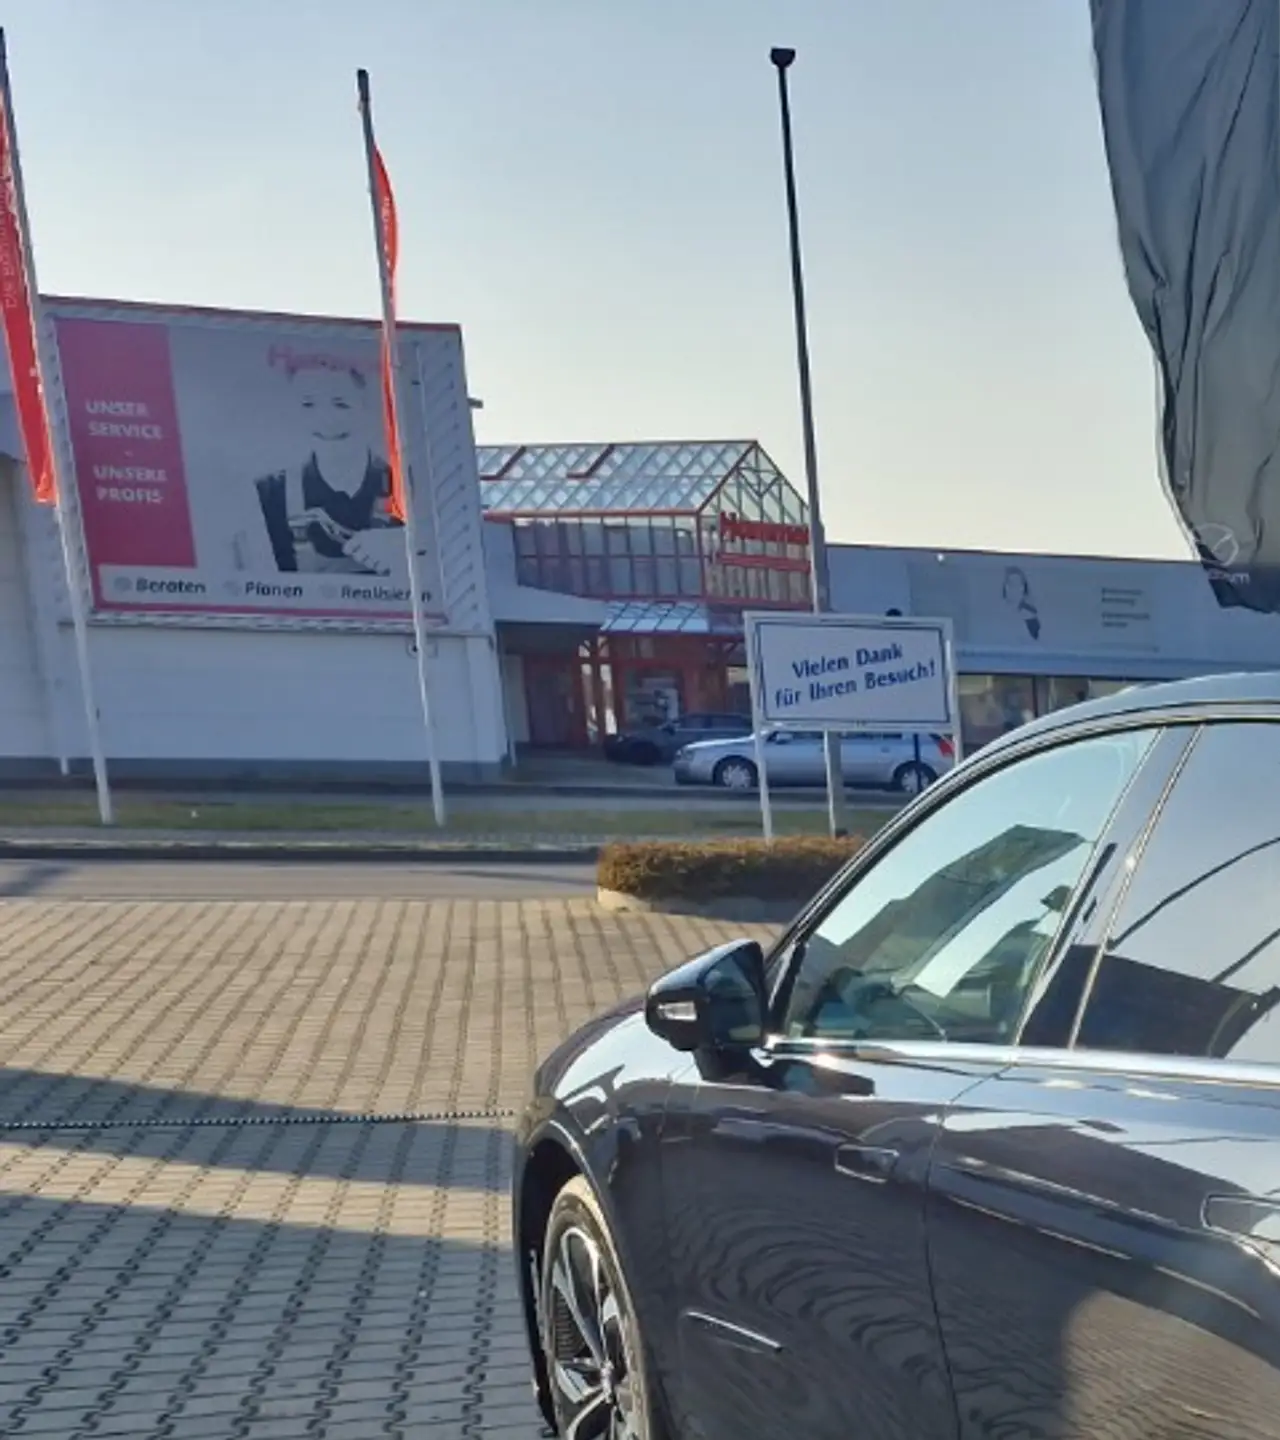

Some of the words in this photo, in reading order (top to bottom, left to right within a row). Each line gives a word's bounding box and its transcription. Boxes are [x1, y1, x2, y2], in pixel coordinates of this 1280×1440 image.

[85, 400, 150, 417] UNSER
[88, 421, 164, 439] SERVICE
[93, 464, 168, 482] UNSERE
[135, 577, 206, 594] Beraten
[245, 581, 303, 598] Planen
[341, 585, 432, 603] Realisiern
[792, 655, 849, 678] Vielen
[856, 643, 903, 665] Dank
[775, 688, 801, 708] für
[809, 679, 858, 700] Ihren
[864, 658, 935, 690] Besuch!
